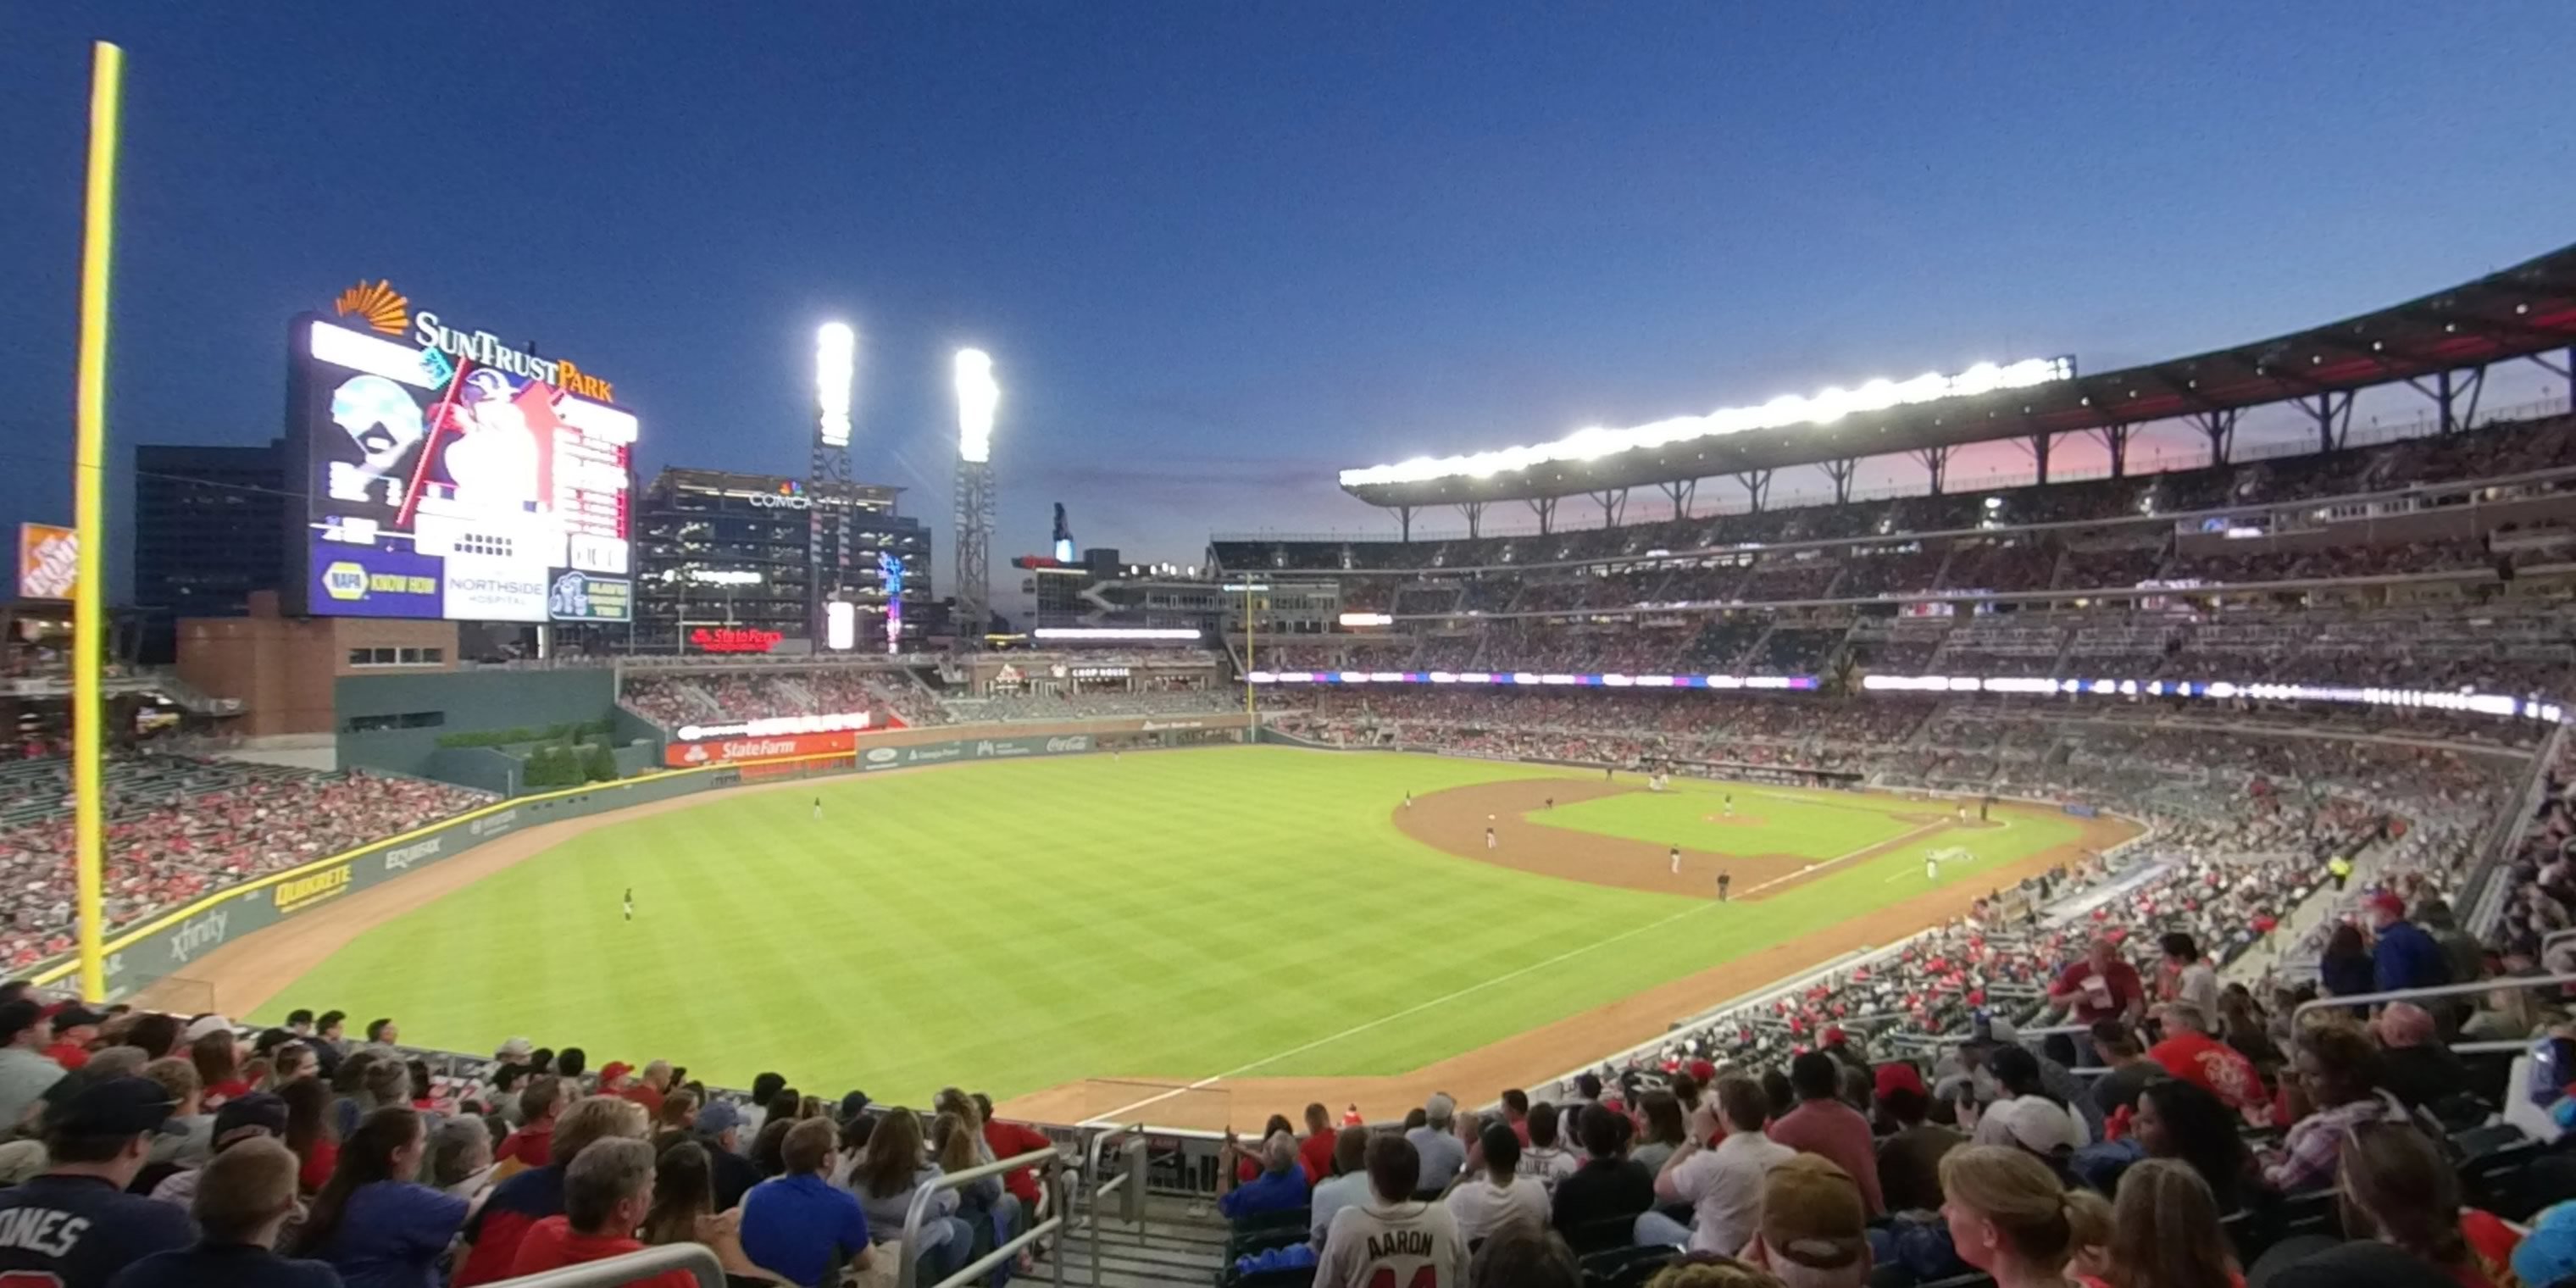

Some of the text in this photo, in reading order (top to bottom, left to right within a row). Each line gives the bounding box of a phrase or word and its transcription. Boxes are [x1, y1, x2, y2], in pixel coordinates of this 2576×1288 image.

[557, 358, 614, 403] PARK
[448, 578, 543, 596] NORTHSIDE
[275, 864, 352, 906] QUIKRETE
[170, 910, 227, 962] xfinity
[1368, 1230, 1433, 1261] AARON
